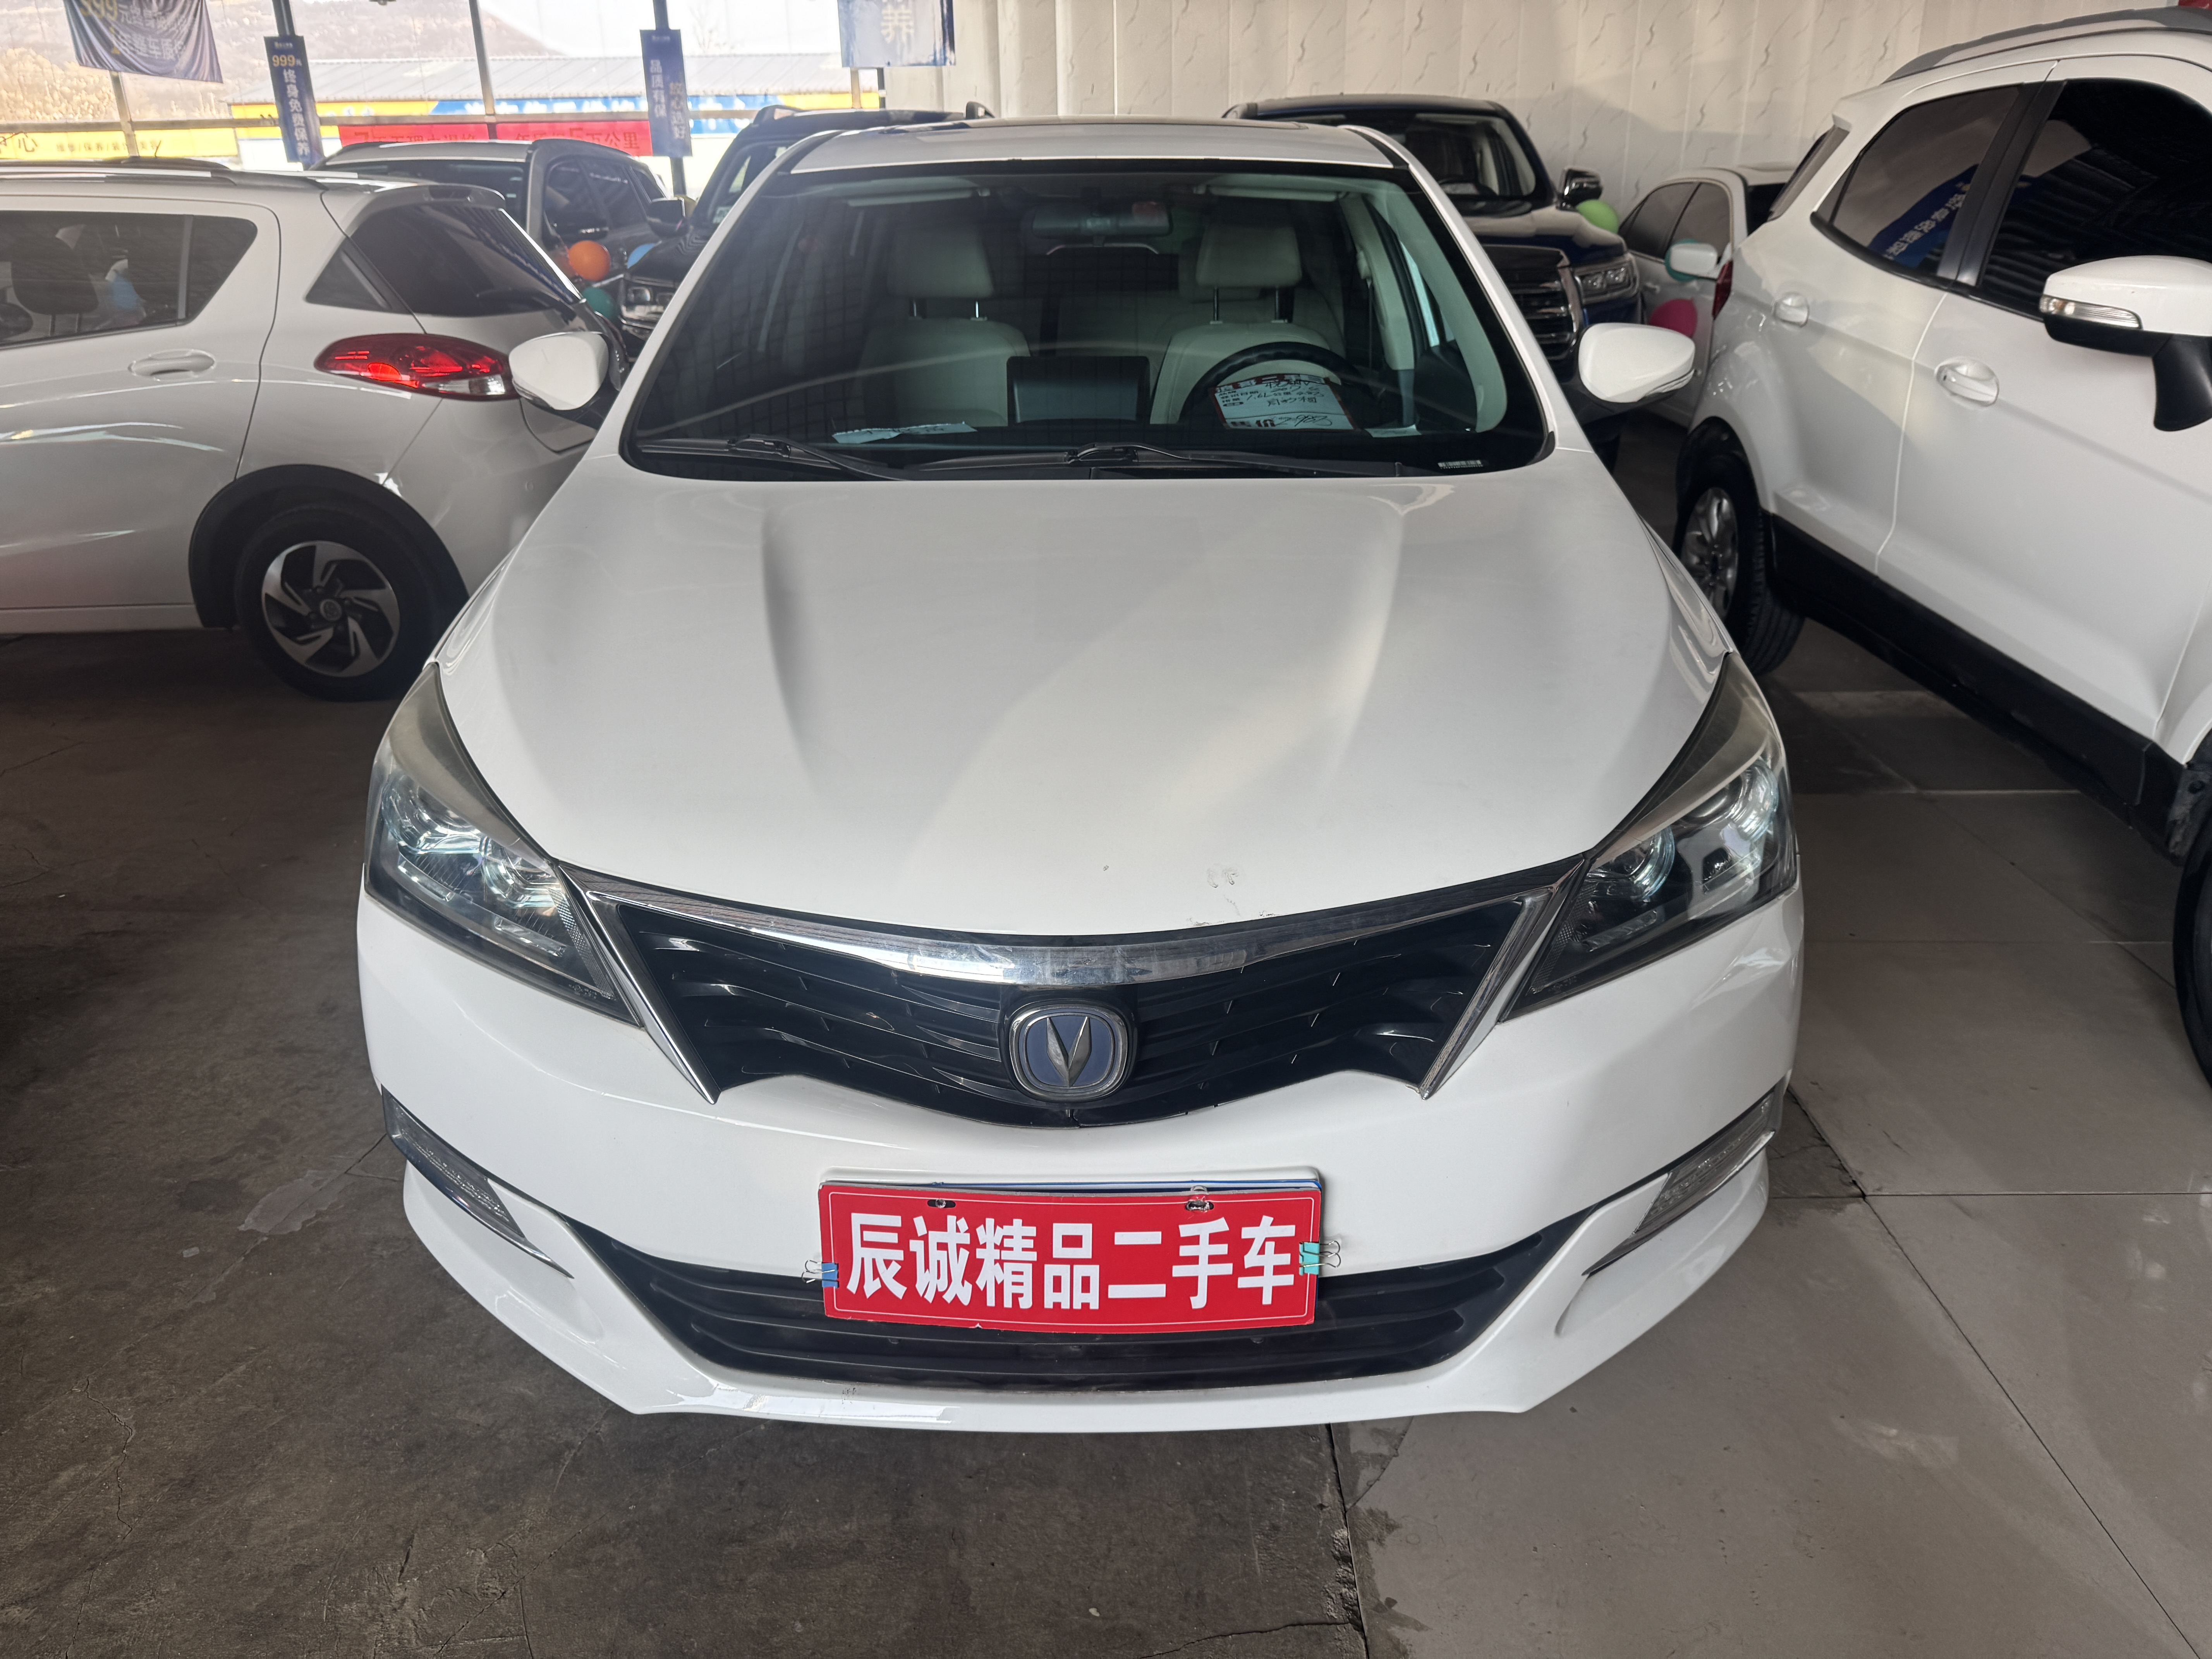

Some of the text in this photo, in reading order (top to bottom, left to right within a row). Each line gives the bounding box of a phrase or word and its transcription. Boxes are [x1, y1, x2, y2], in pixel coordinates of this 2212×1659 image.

[881, 0, 914, 43] 养
[283, 69, 310, 156] 终身免费保养
[847, 1213, 1295, 1310] 辰诚精品二手车
